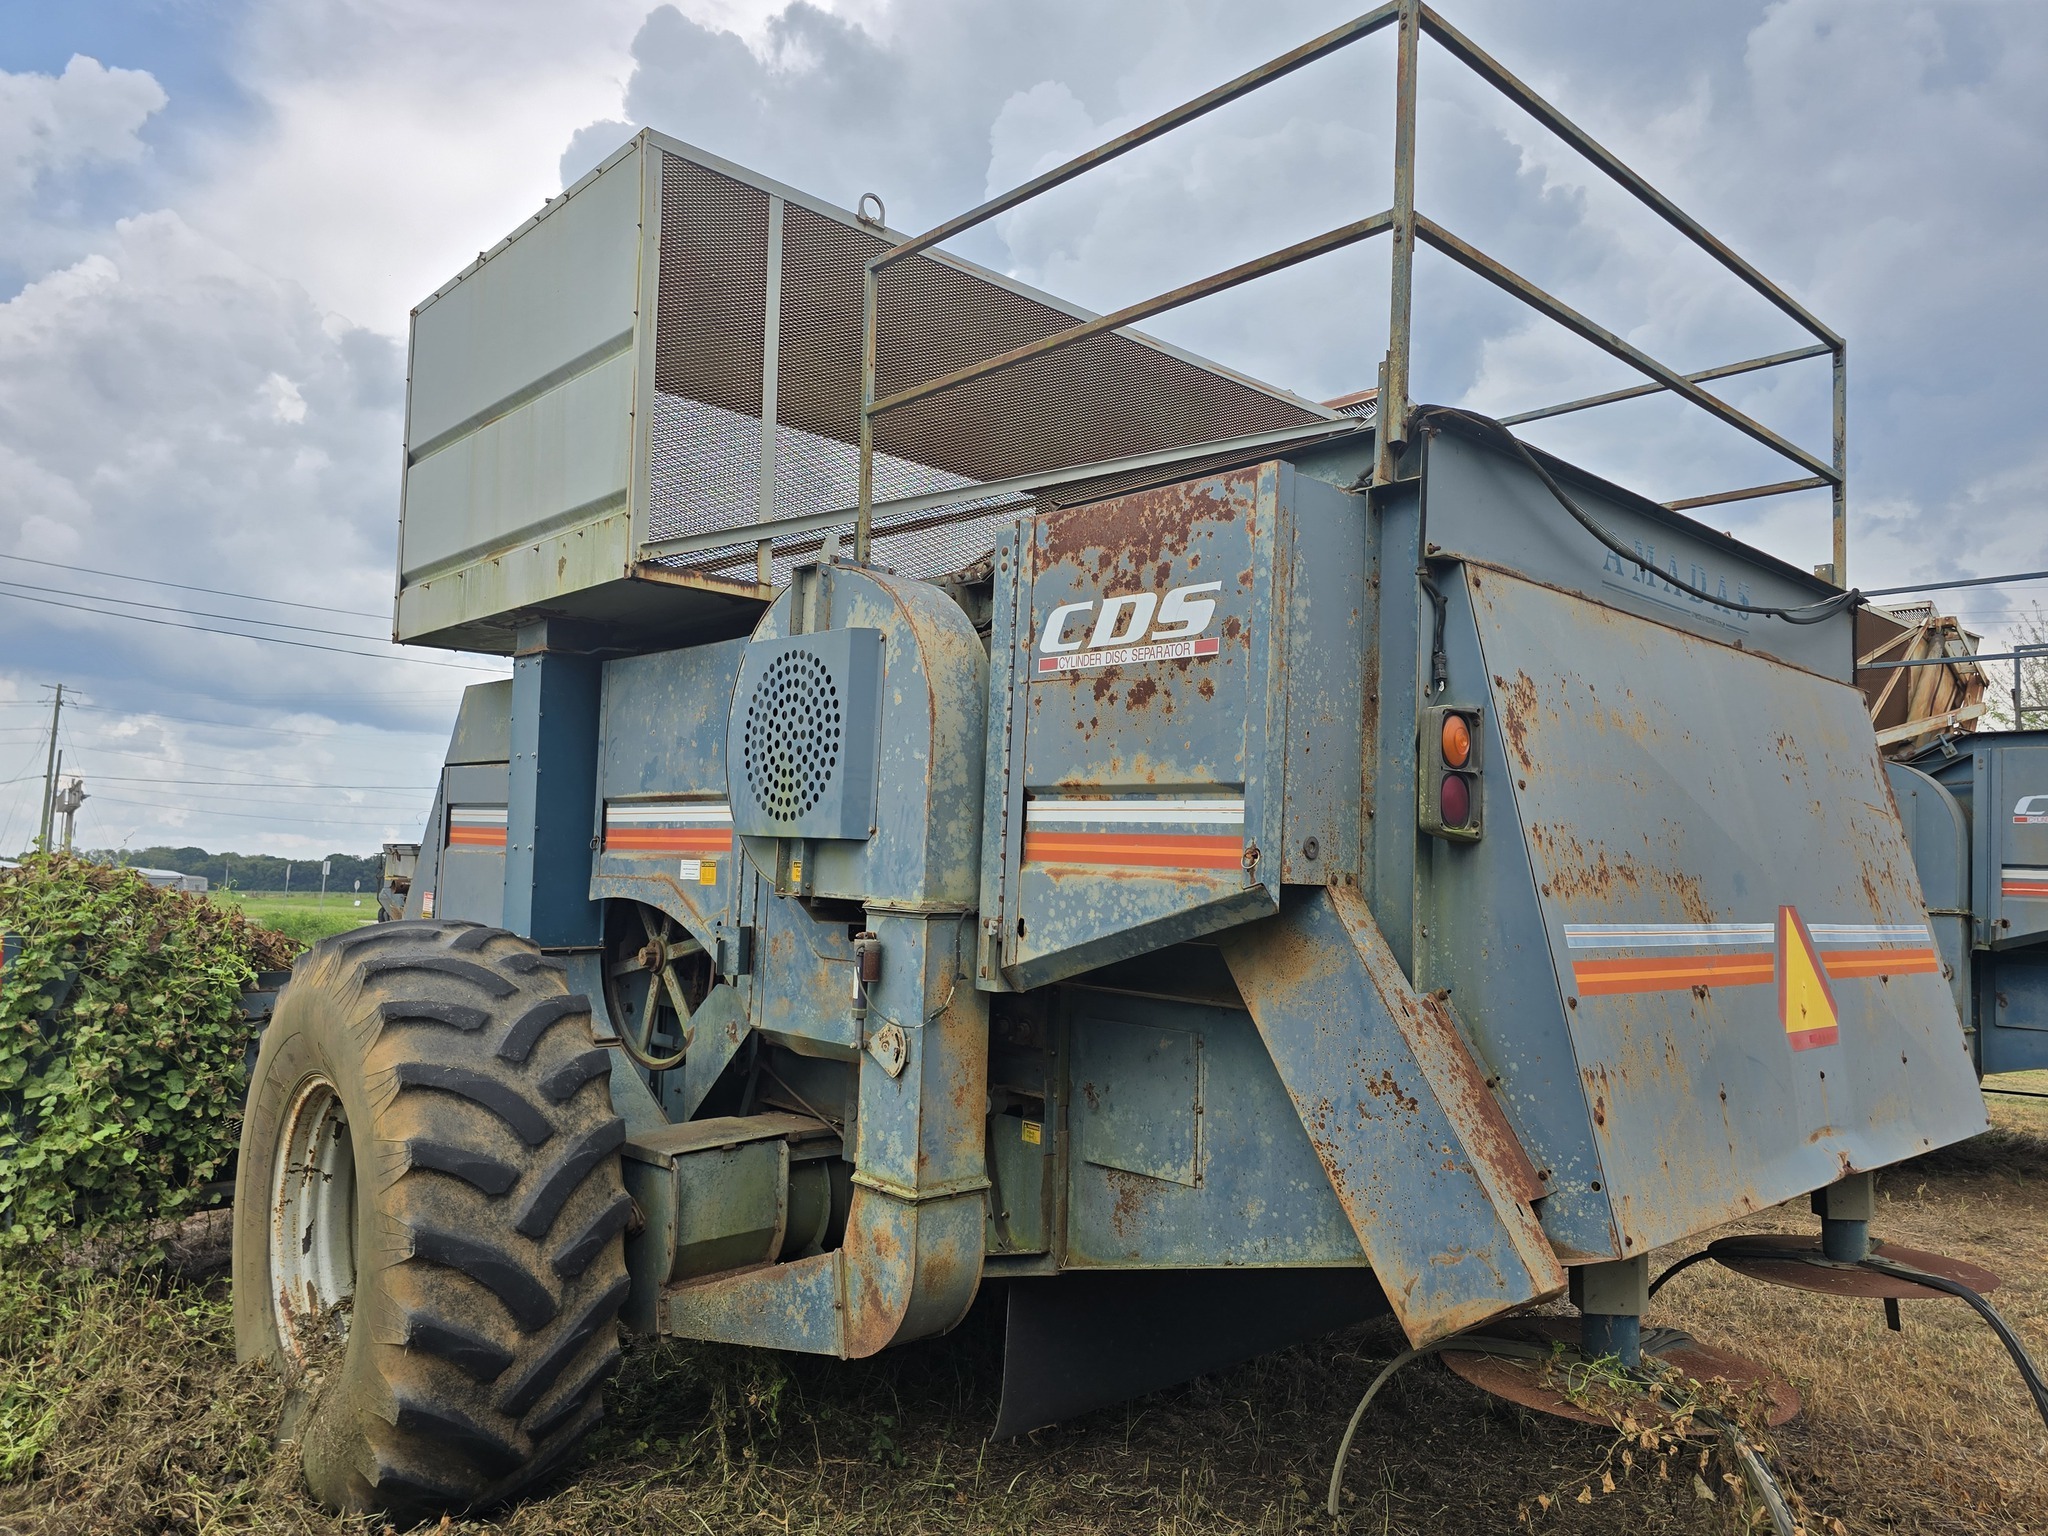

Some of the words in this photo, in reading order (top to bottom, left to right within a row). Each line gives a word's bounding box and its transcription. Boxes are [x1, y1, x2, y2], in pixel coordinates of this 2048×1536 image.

[1039, 580, 1223, 654] CDS
[1058, 653, 1102, 670] CYLINDER
[1105, 649, 1128, 665] DISC
[1131, 642, 1191, 662] SEPARATOR
